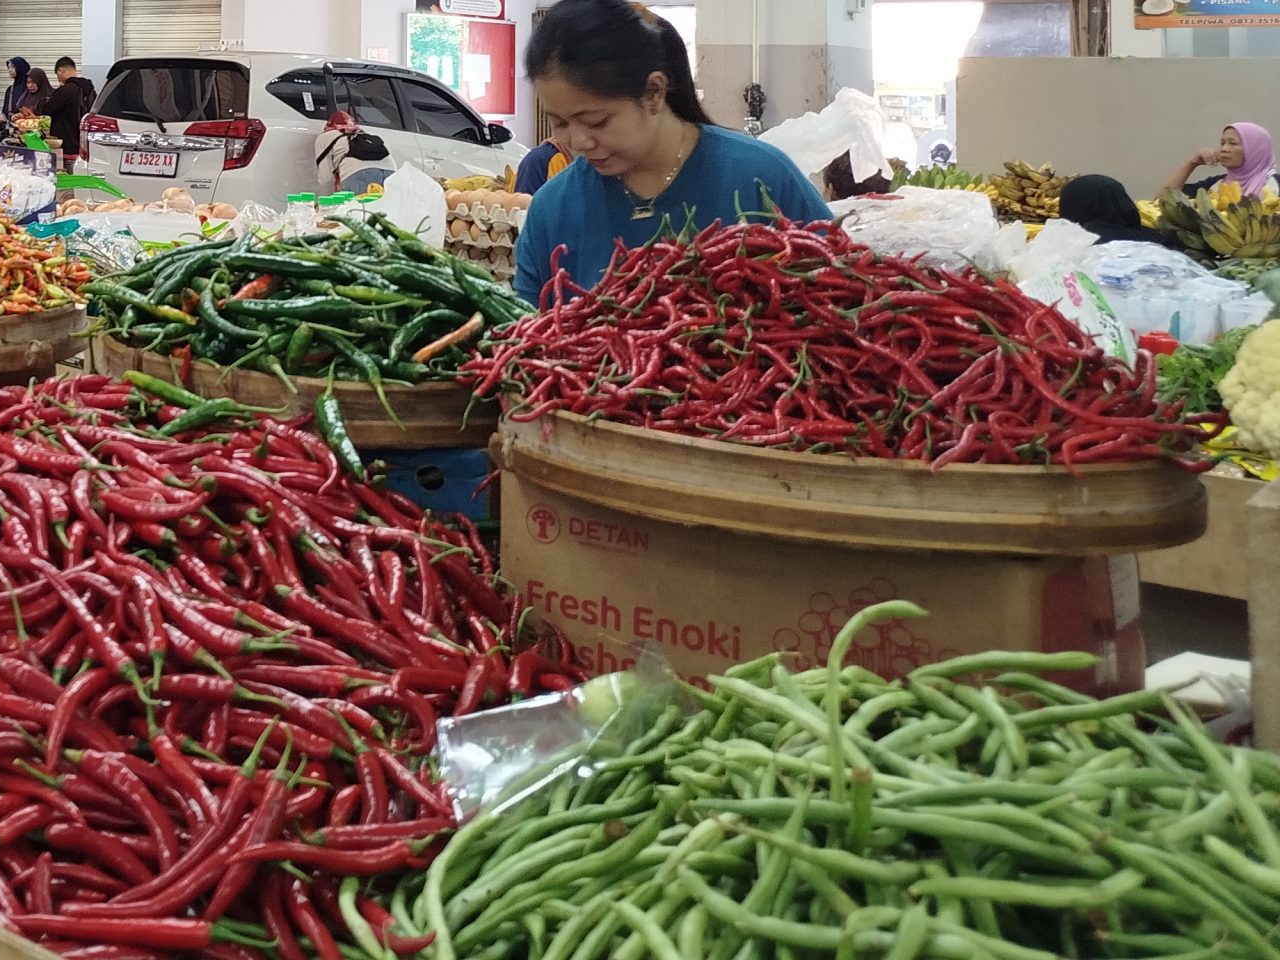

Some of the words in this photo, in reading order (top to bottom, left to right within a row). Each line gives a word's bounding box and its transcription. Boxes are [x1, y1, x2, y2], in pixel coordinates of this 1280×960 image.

[124, 152, 135, 165] AE
[569, 516, 649, 552] DETAN
[526, 578, 621, 632] Fresh
[633, 605, 741, 662] Enoki
